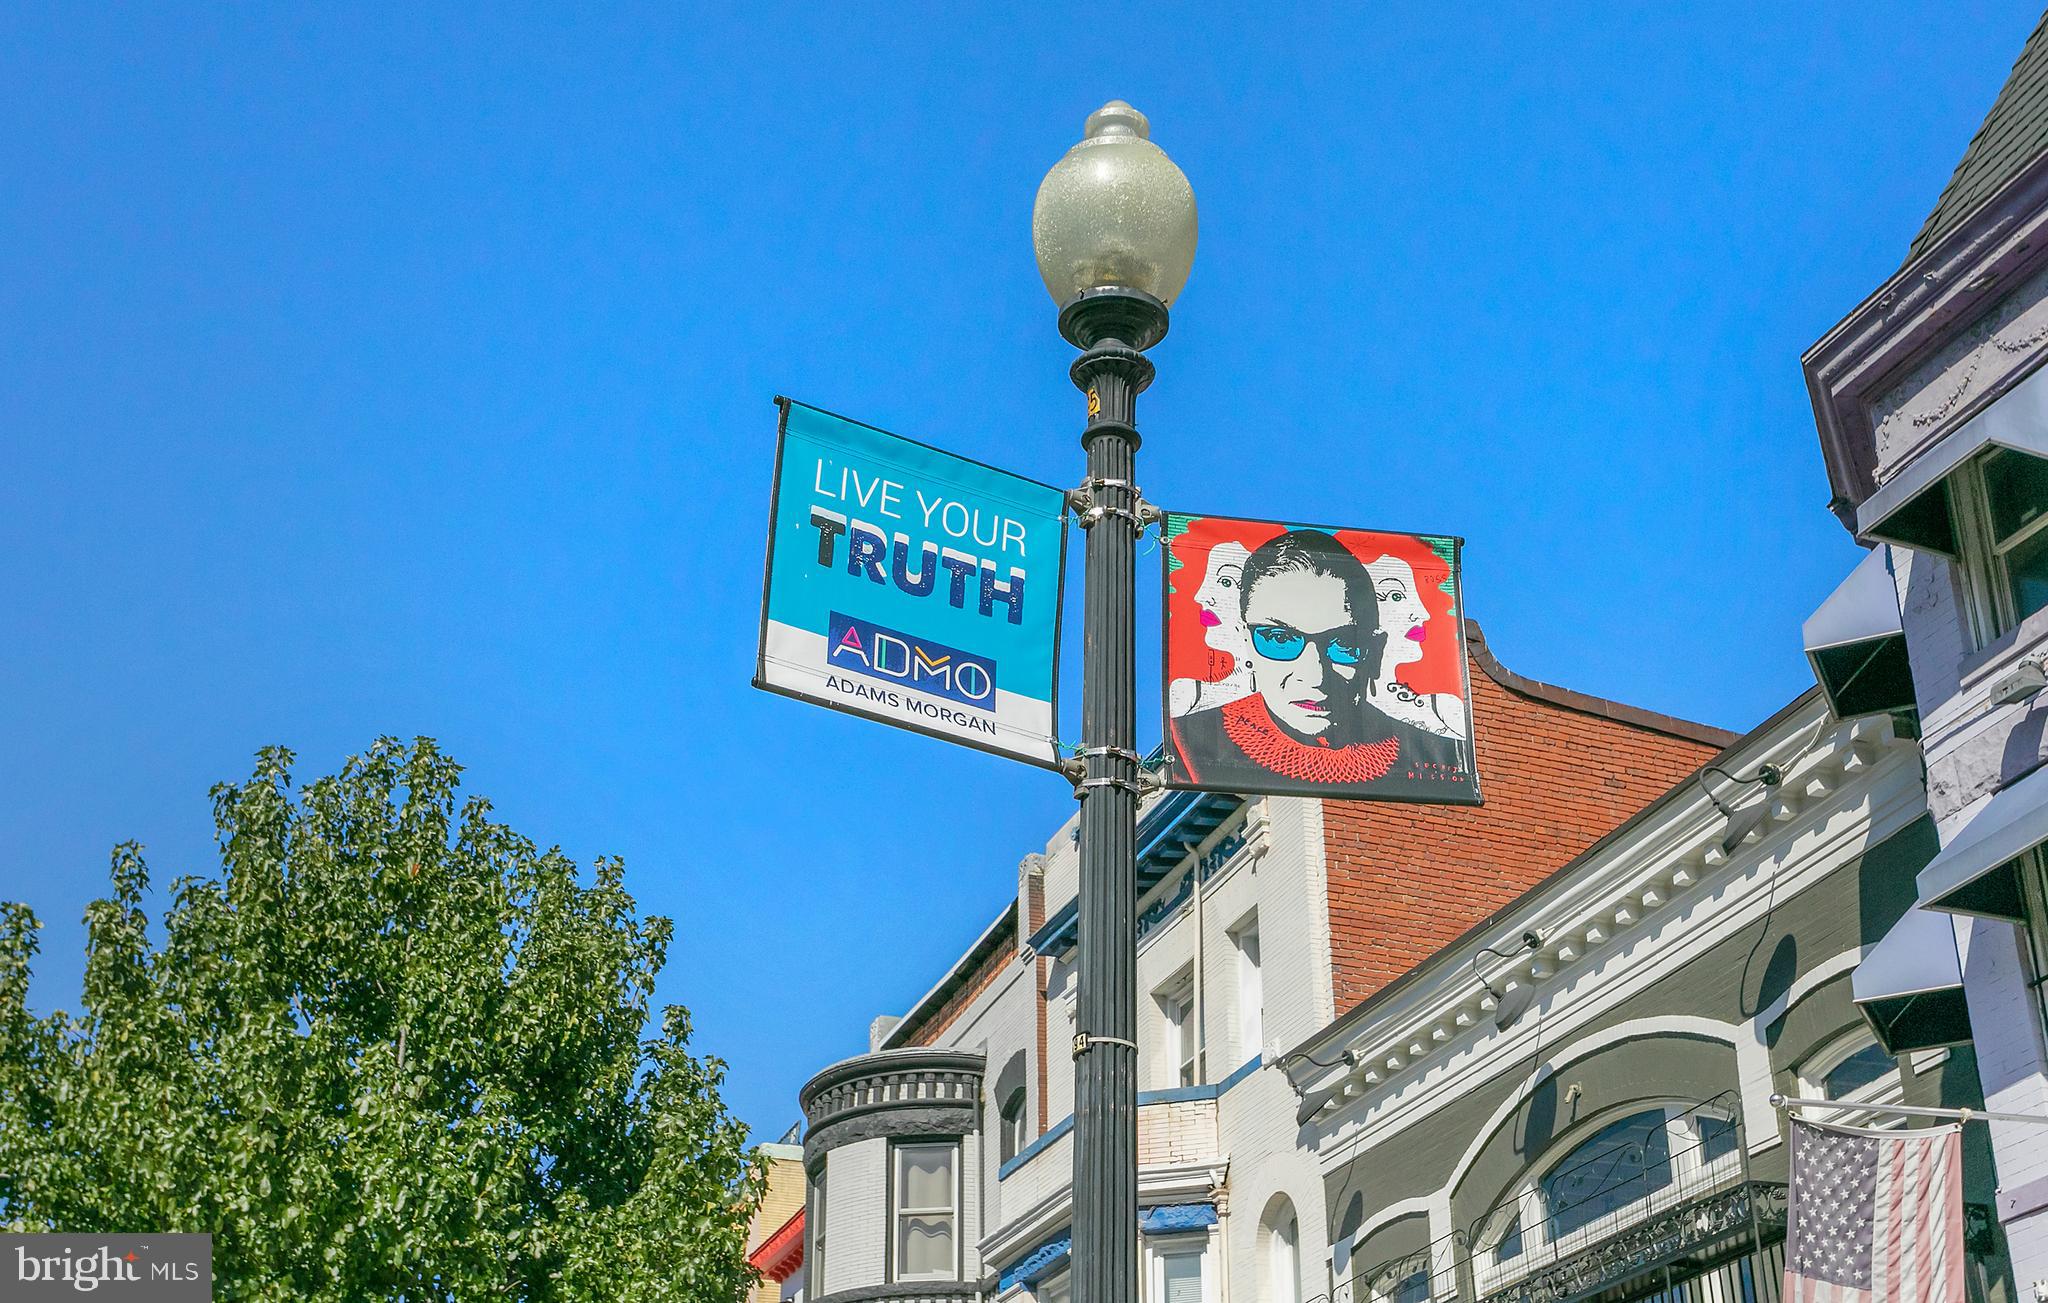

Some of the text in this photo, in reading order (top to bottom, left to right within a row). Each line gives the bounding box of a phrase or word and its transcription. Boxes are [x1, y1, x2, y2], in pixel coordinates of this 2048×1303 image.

[814, 458, 1026, 557] LIVE YOUR
[810, 504, 1026, 626] TRUTH
[826, 675, 997, 736] ADAMS MORGAN
[832, 626, 991, 700] ADMO
